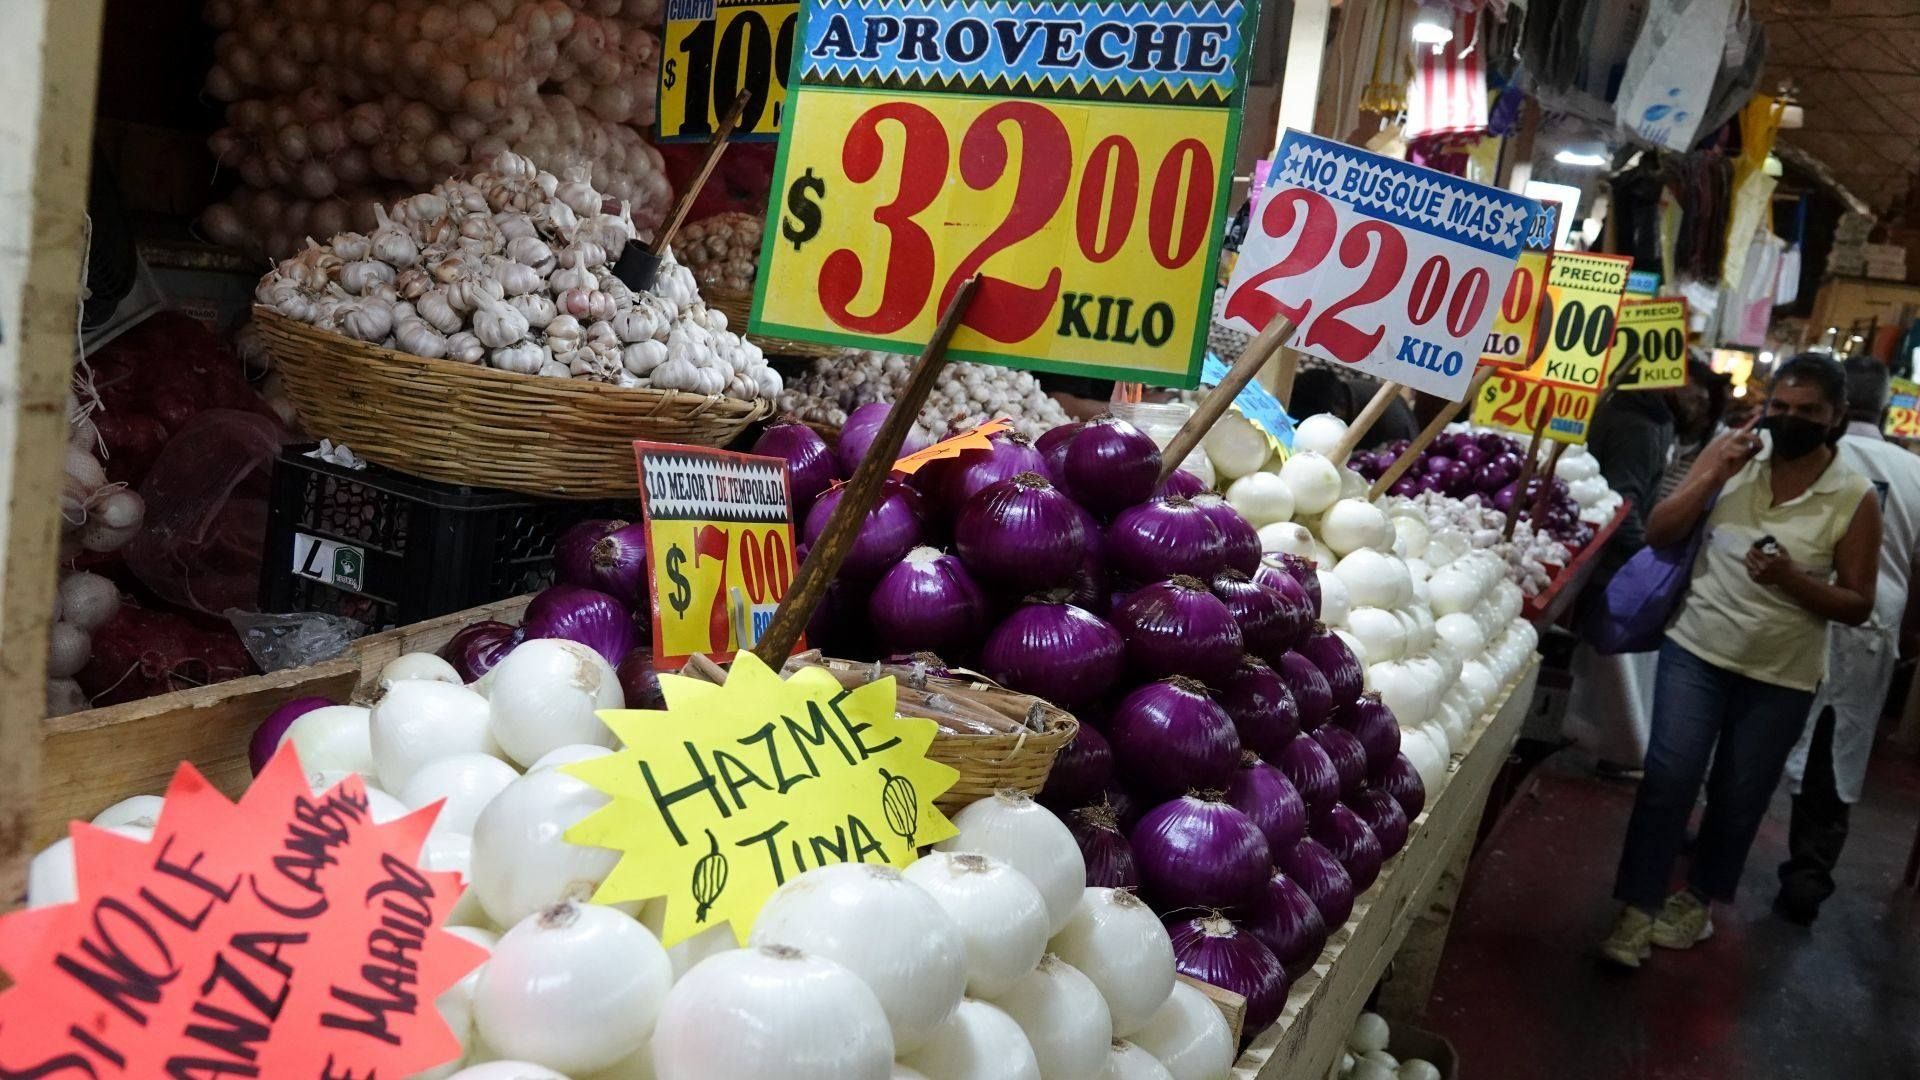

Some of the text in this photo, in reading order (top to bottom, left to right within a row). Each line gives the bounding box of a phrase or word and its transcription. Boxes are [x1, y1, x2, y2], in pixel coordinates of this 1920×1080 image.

[811, 14, 1229, 74] APROVECHE
[1299, 154, 1505, 236] NO BUSQUE MAS
[1560, 266, 1620, 285] PRECIO
[1057, 291, 1176, 347] KILO
[1636, 307, 1680, 318] PRECIO
[1396, 336, 1464, 377] KILO
[1545, 360, 1600, 384] KILO
[1644, 367, 1683, 382] KILO
[649, 471, 787, 506] LO MEJOR Y DE TEMPORADA
[638, 689, 903, 847] HAZME
